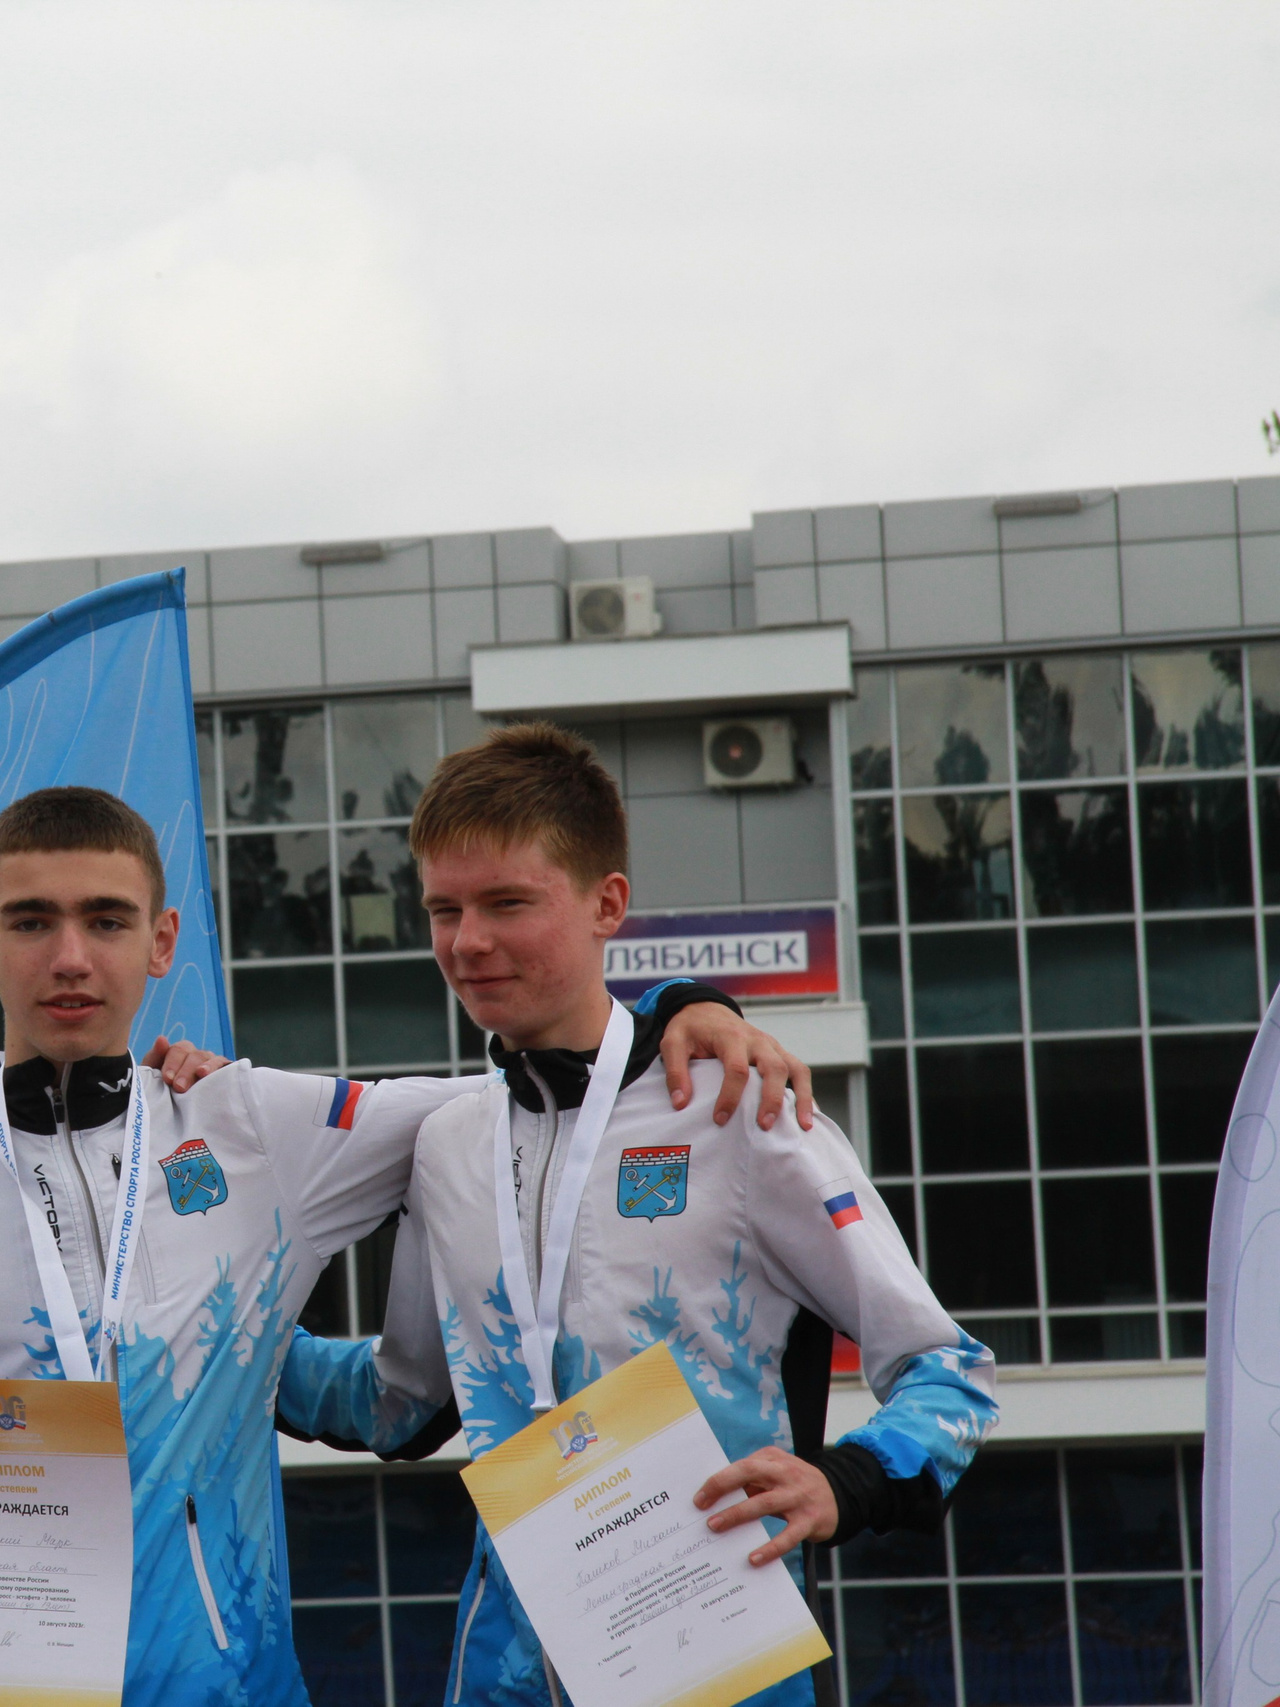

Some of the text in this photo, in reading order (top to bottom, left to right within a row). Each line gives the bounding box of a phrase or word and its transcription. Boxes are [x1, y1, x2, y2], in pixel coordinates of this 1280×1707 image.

[606, 938, 799, 973] ЛЯБИНСК
[131, 1099, 144, 1166] РОССИЙСКОЙ
[126, 1167, 139, 1208] СПОРТА
[111, 1210, 133, 1300] МИНИСТЕРСТВО
[0, 1484, 38, 1494] степени
[573, 1466, 632, 1511] ДИПЛОМ
[594, 1490, 632, 1517] степени
[575, 1491, 670, 1551] НАГРАЖДАЕТСЯ
[29, 1560, 68, 1574] область
[628, 1575, 665, 1600] Первенстве
[663, 1563, 686, 1579] России
[14, 1585, 69, 1594] ориентированию
[617, 1590, 658, 1617] спортивному
[657, 1561, 711, 1594] ориентированию
[707, 1591, 729, 1607] августа
[614, 1621, 638, 1638] группе:
